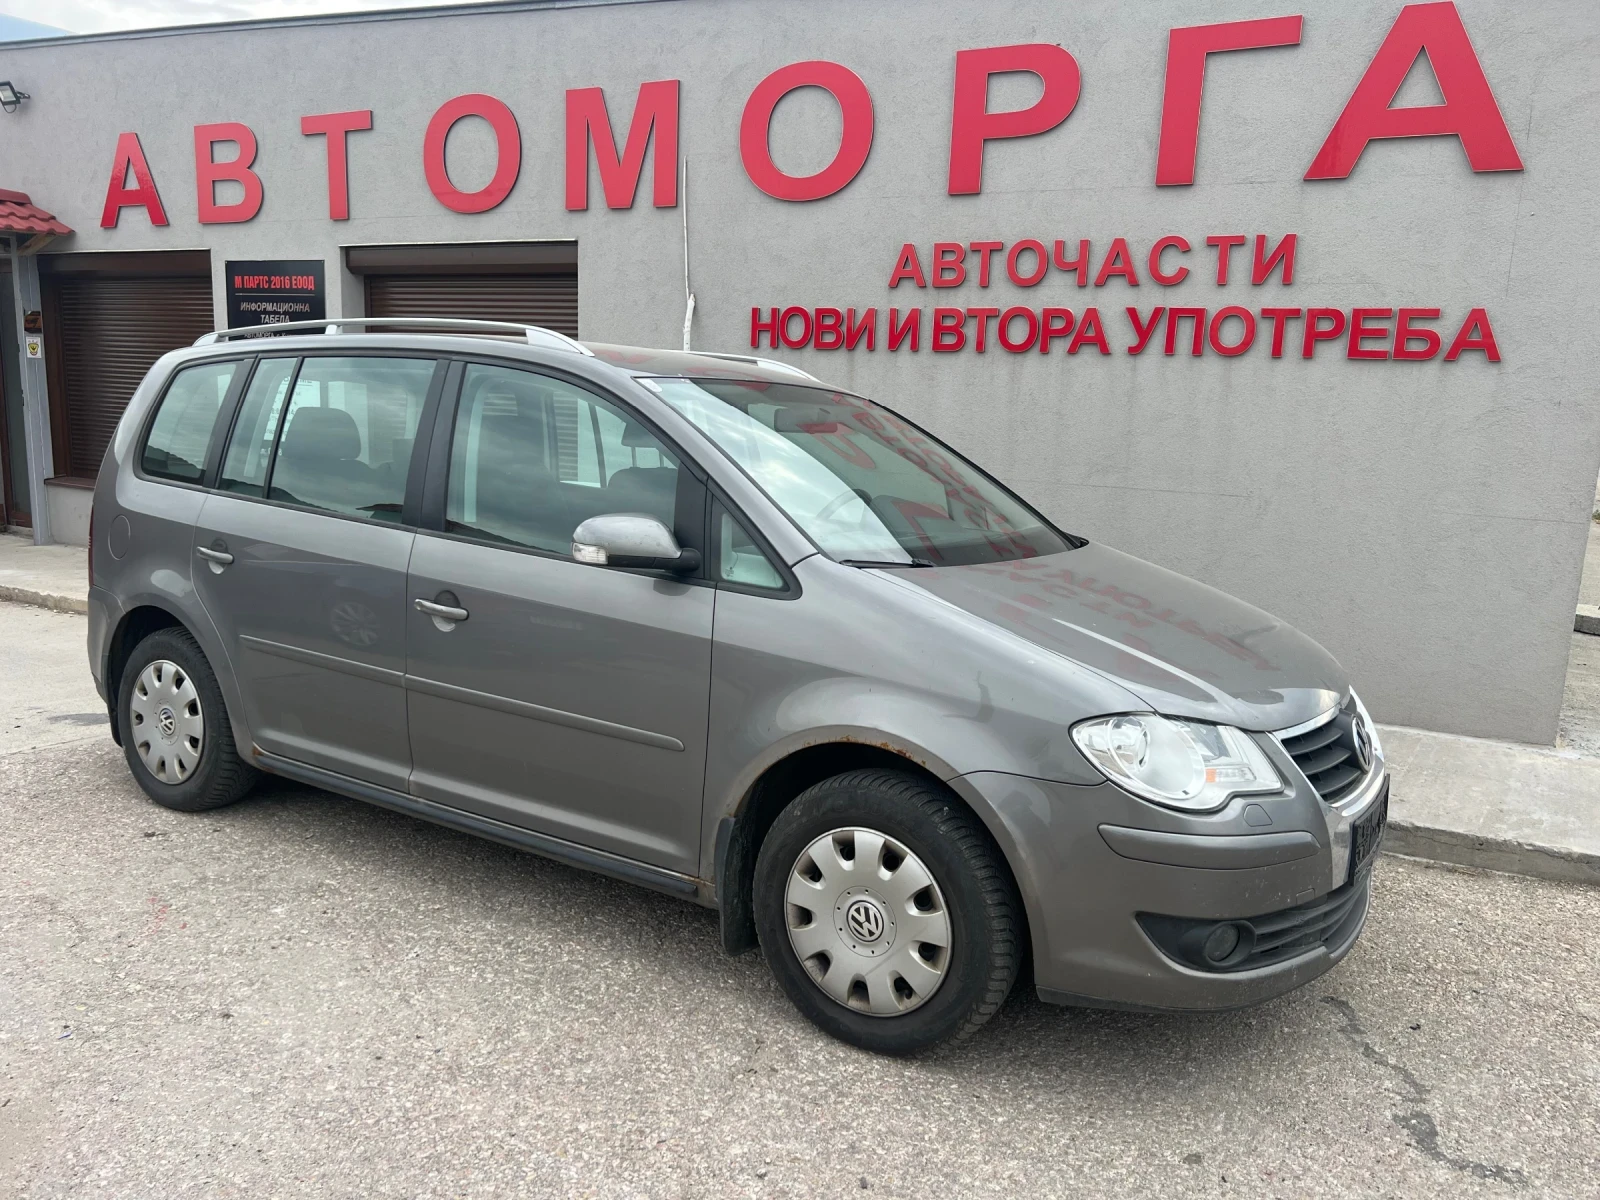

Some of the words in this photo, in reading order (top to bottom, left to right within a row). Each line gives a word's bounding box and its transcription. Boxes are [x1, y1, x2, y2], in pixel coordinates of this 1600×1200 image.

[101, 1, 1524, 228] АВТОМОРГА
[234, 276, 242, 289] М
[244, 275, 269, 289] ПАРТС
[271, 276, 290, 289] 2016
[292, 276, 315, 291] ЕООД
[889, 234, 1298, 288] АВТОЧАСТИ
[240, 302, 310, 313] ИНФОРМАЦИОННА
[751, 306, 877, 352] НОВИ
[887, 307, 921, 353] И
[931, 307, 1111, 355] ВТОРА
[1126, 307, 1501, 362] УПОТРЕБА
